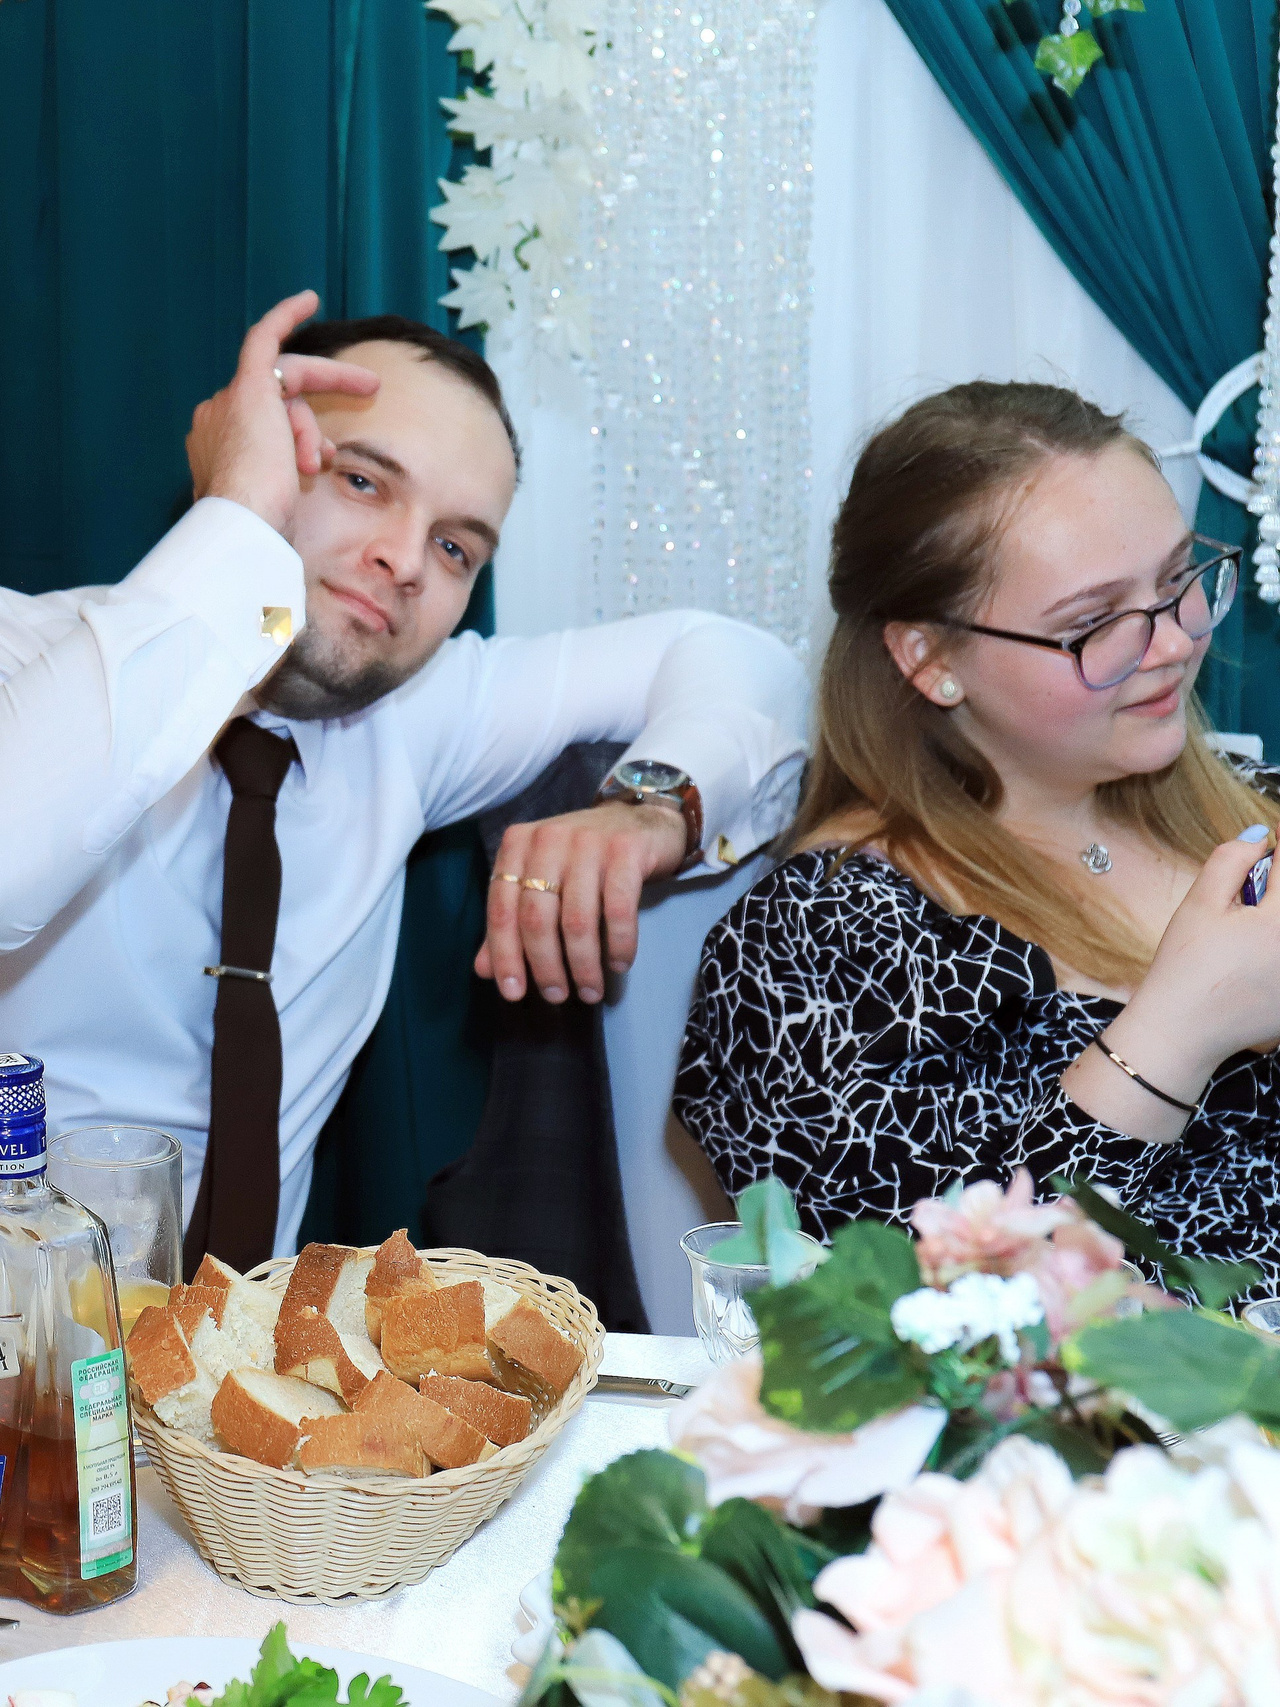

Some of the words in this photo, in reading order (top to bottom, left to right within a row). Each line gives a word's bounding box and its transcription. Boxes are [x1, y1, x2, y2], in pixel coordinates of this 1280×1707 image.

[41, 1136, 46, 1148] T
[78, 1359, 119, 1376] РОССИЙСКАЯ
[78, 1365, 119, 1382] ФЕДЕРАЦИЯ
[80, 1394, 122, 1412] ФЕДЕРАЛЬНАЯ
[80, 1401, 123, 1419] СПЕЦИАЛЬНАЯ
[92, 1411, 113, 1422] МАРКА
